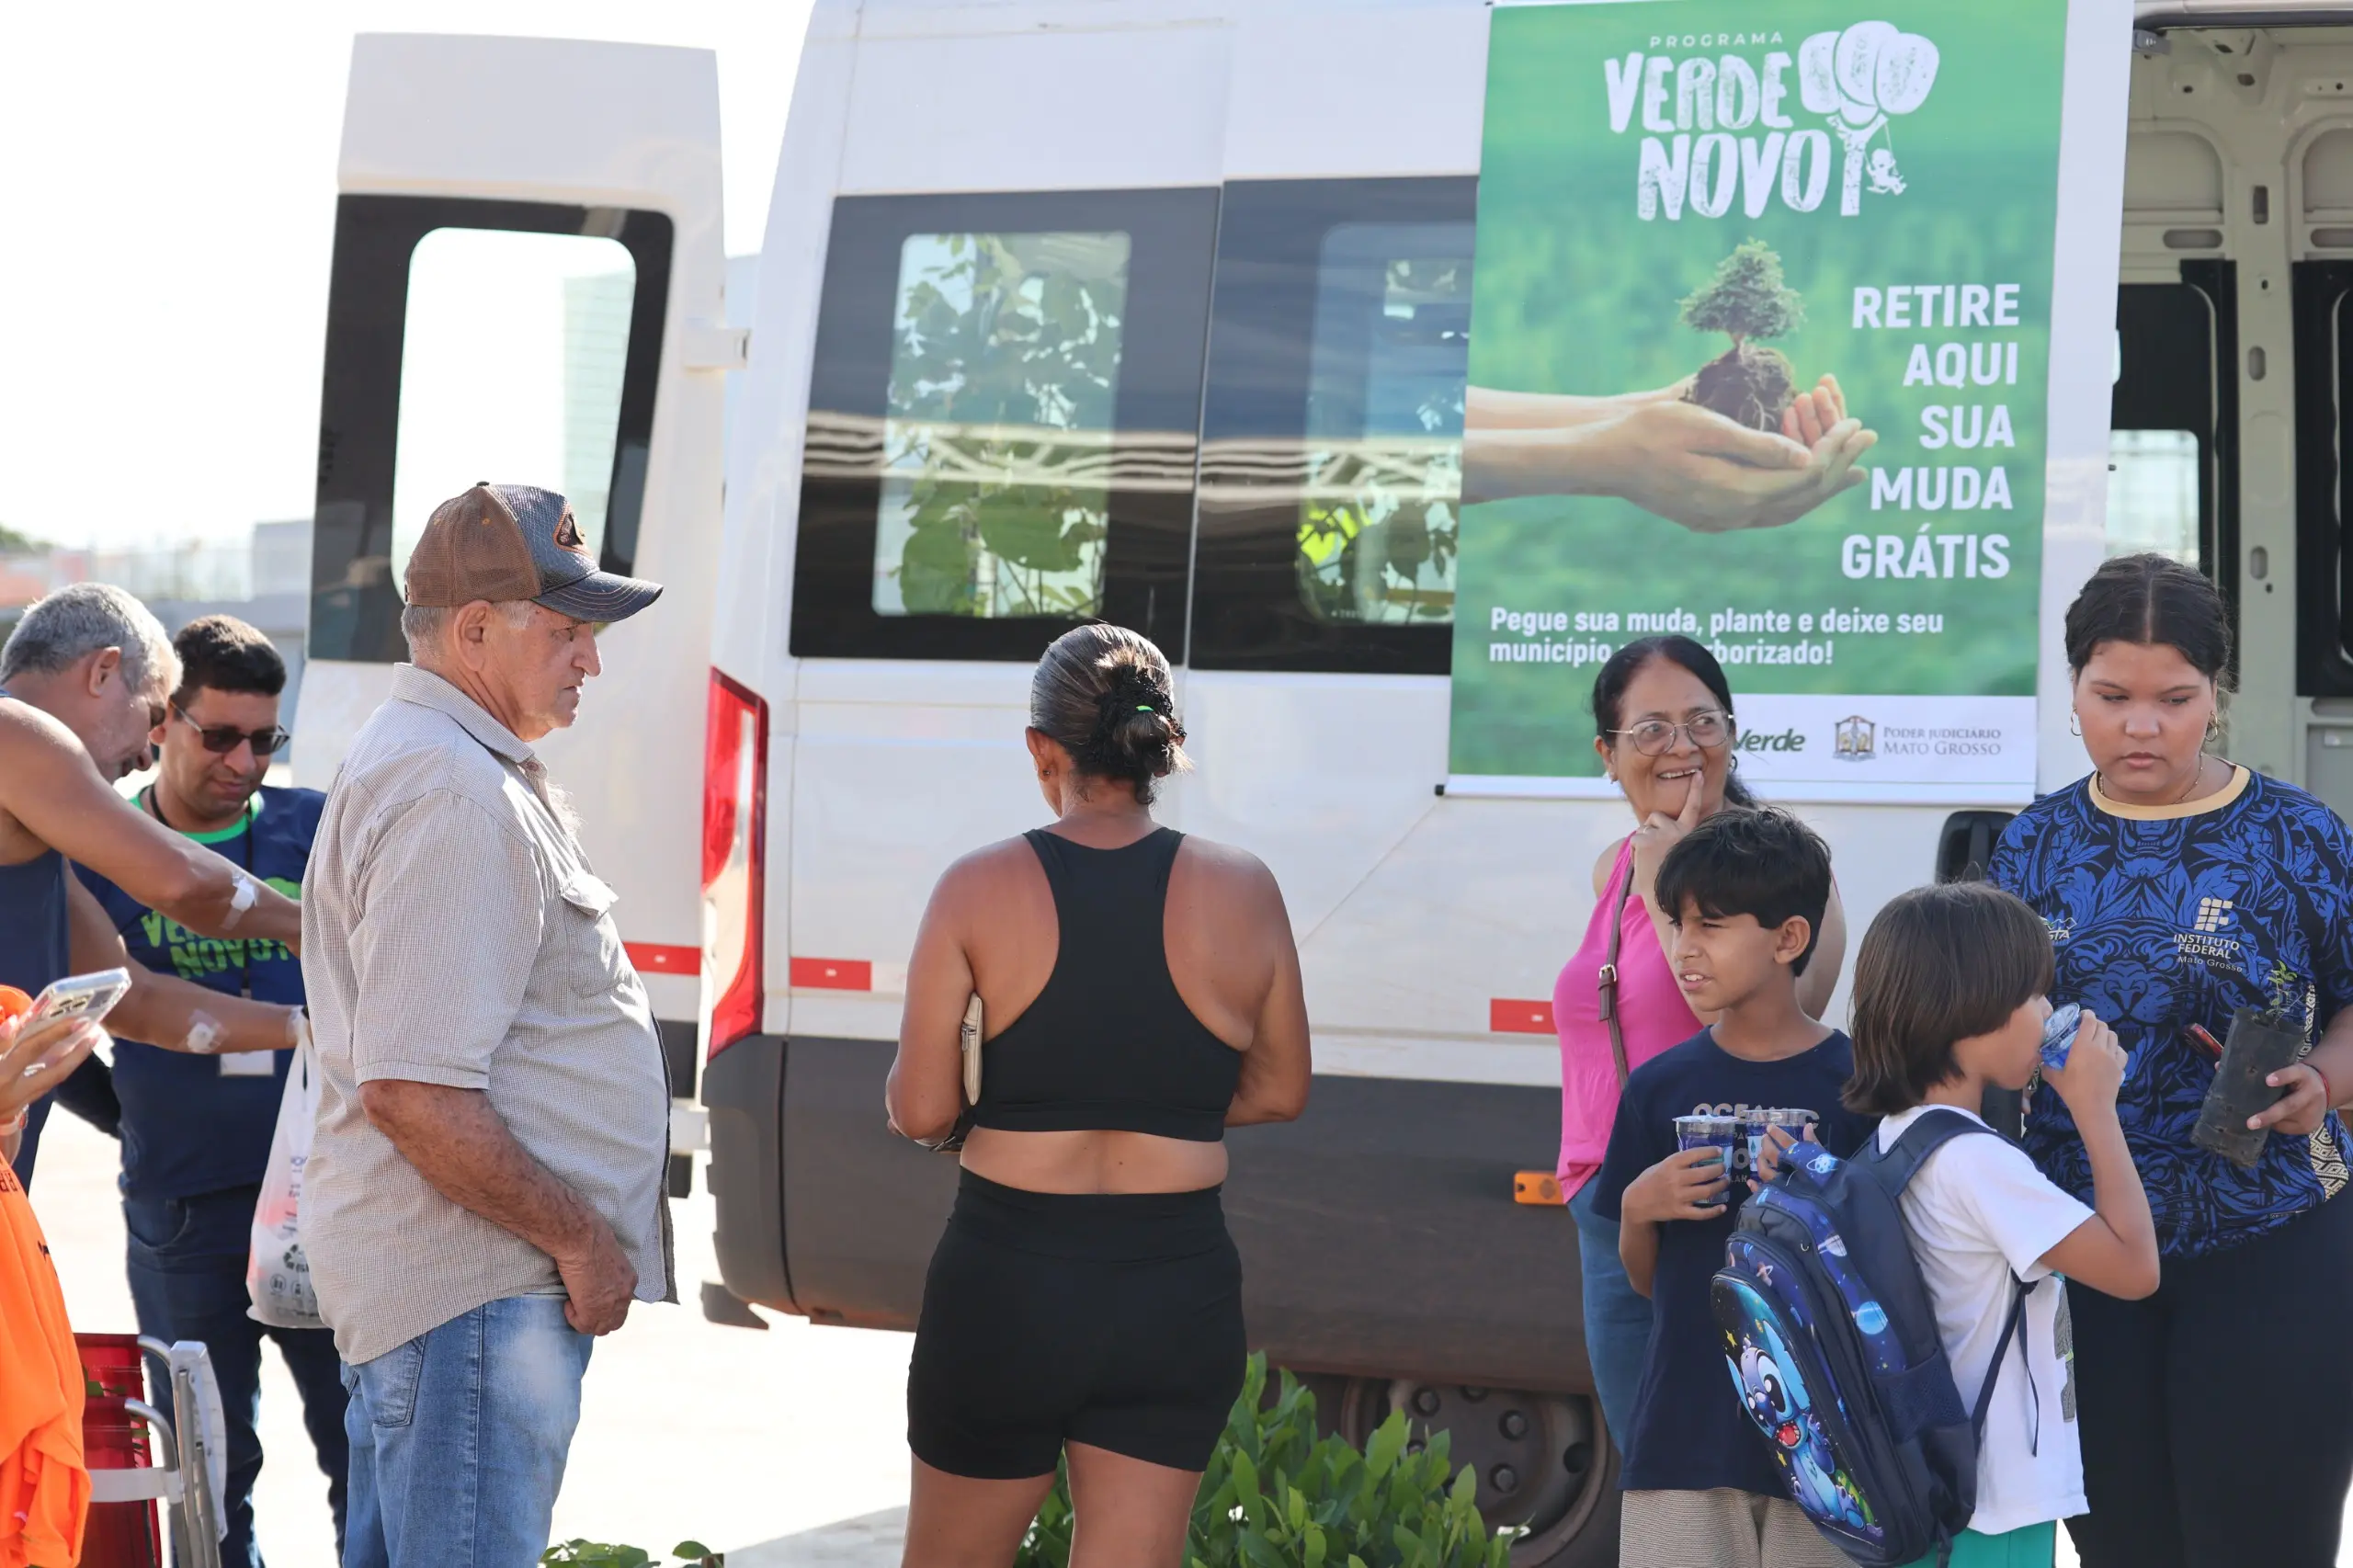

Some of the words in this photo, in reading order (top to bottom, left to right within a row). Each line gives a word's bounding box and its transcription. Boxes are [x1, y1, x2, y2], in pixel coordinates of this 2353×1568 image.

[1650, 31, 1784, 49] PROGRAMA
[1604, 51, 1794, 133] VERDE
[1637, 129, 1831, 221] NOVO
[1852, 283, 2020, 329] RETIRE
[1903, 342, 2018, 390] AQUI
[1919, 404, 2016, 449] SUA
[1870, 466, 2013, 511] MUDA
[1841, 522, 2011, 580] GRÁTIS
[1490, 607, 1568, 637] Pegue
[1574, 611, 1620, 632] sua
[1626, 607, 1703, 637] muda,
[1710, 607, 1790, 638] plante
[1798, 613, 1813, 632] e
[1820, 607, 1890, 633] deixe
[1896, 613, 1943, 633] seu
[1489, 637, 1609, 668] município
[2173, 933, 2240, 951] INSTITUTO
[2177, 943, 2232, 960] FEDERAL
[2177, 956, 2204, 965] Mato
[2207, 959, 2243, 972] Grosso
